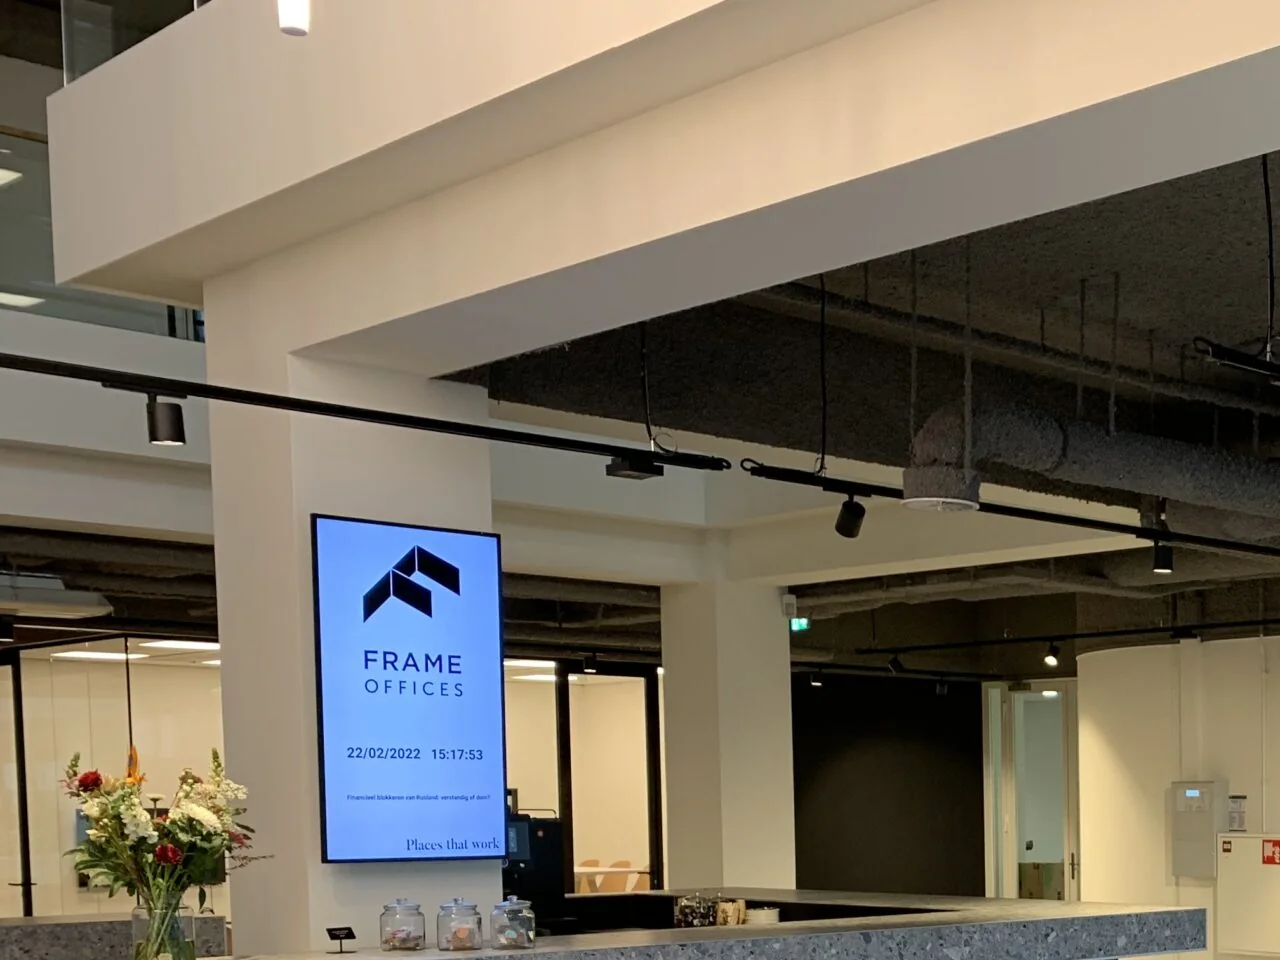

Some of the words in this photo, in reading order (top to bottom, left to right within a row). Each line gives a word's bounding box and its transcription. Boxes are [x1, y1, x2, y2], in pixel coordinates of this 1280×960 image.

[364, 650, 462, 674] FRAME
[364, 678, 463, 697] OFFICES
[346, 746, 421, 760] 22/02/2022
[431, 748, 484, 761] 15:17:53
[406, 837, 443, 851] Places
[446, 836, 468, 850] that
[471, 836, 500, 850] work
